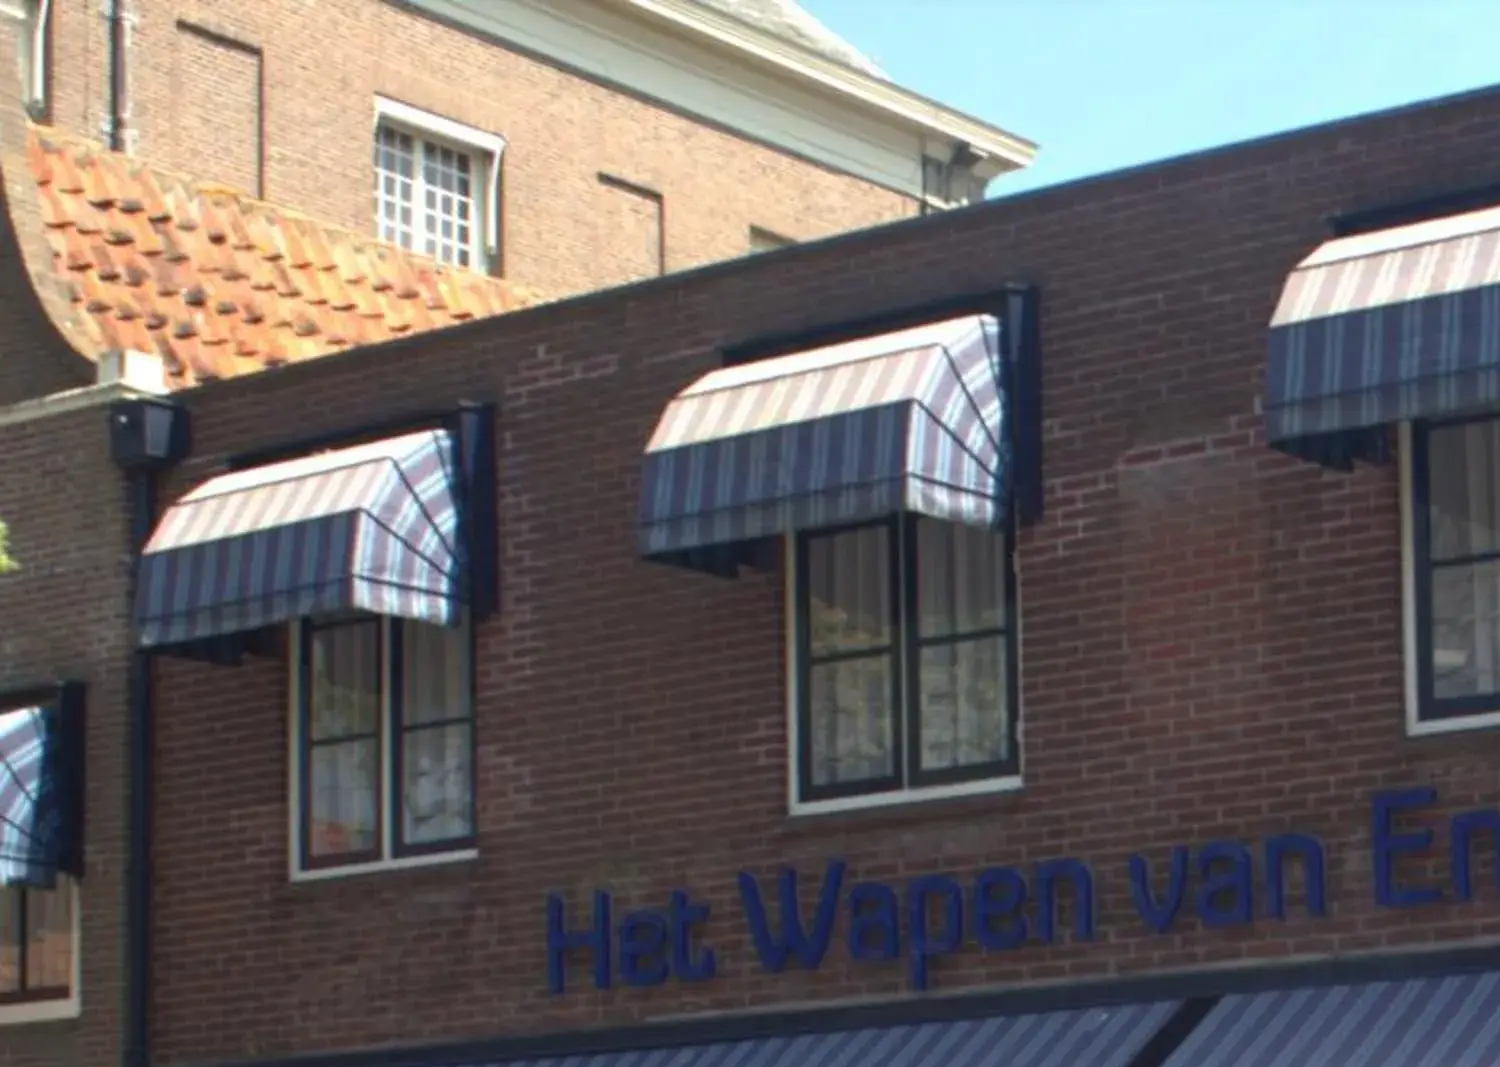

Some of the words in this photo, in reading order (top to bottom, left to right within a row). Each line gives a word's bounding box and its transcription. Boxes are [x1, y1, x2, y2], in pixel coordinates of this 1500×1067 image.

[548, 890, 716, 994] Het
[738, 858, 1093, 990] Wapen
[1129, 834, 1325, 932] van
